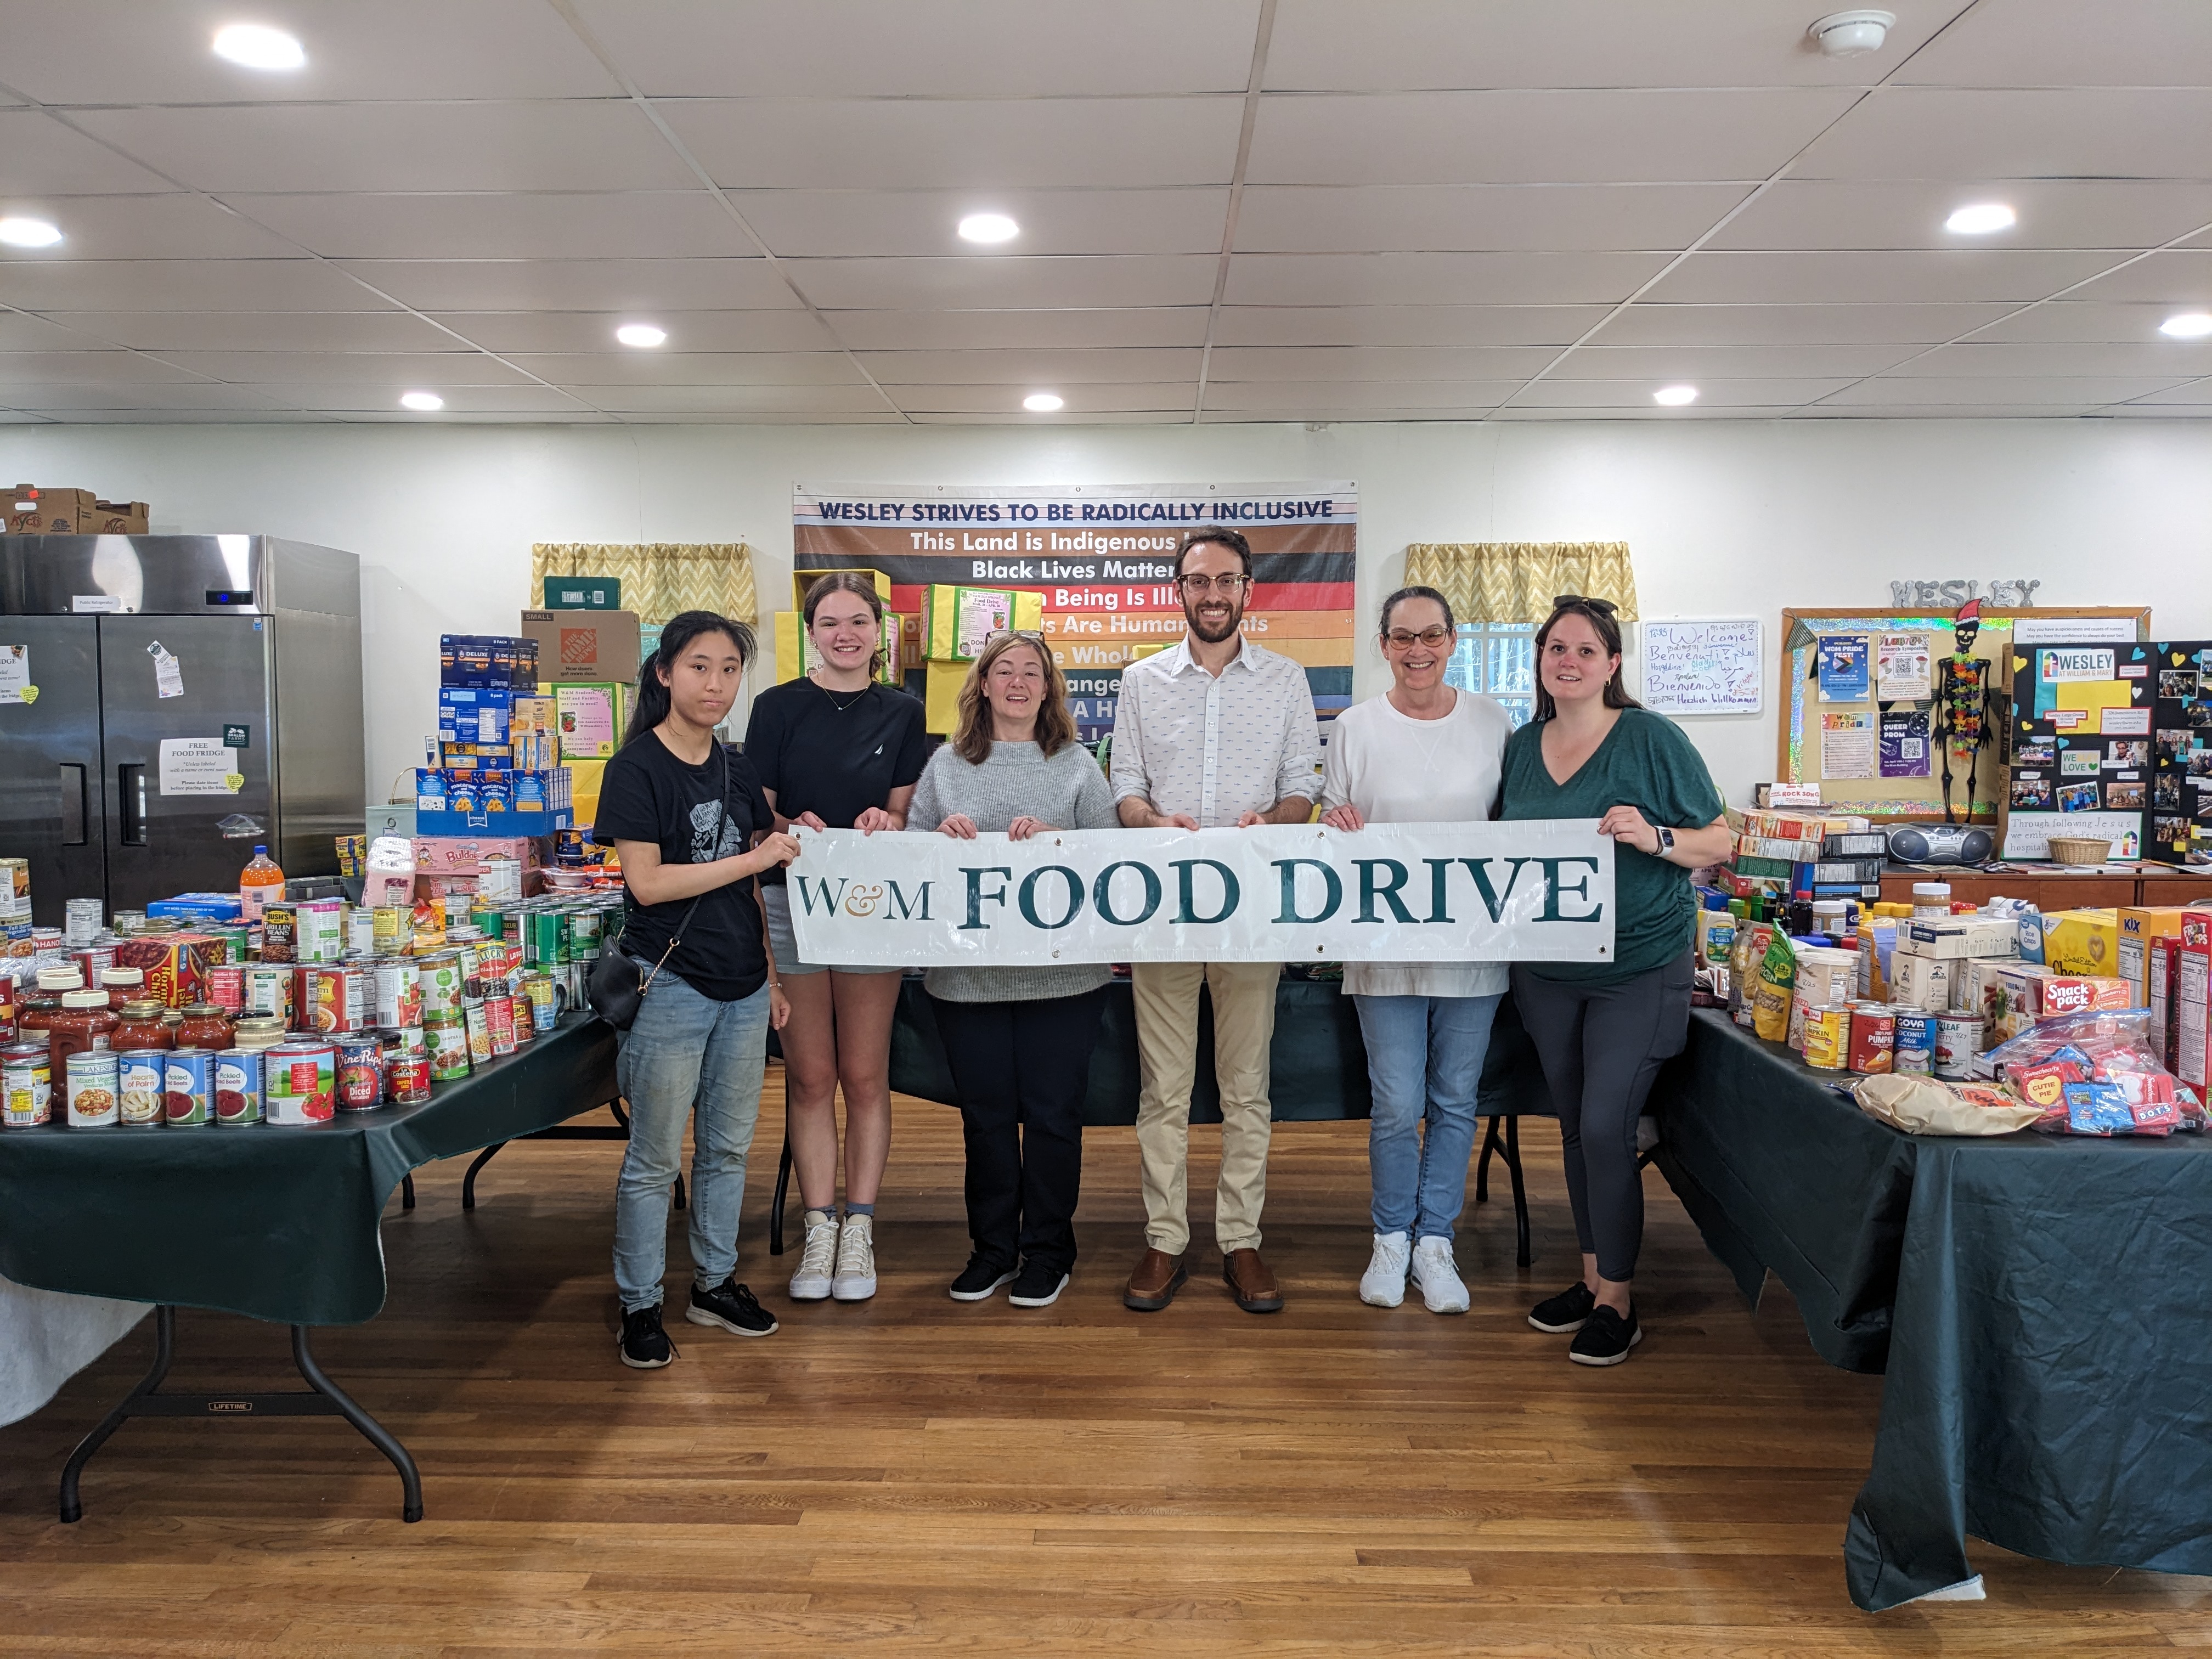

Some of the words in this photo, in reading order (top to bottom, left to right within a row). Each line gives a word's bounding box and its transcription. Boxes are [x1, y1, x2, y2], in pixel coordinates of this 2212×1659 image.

[819, 501, 904, 522] WESLEY
[912, 504, 1001, 522] STRIVES
[1009, 503, 1039, 522] TO
[1048, 504, 1073, 521] BE
[1082, 502, 1205, 522] RADICALLY
[1212, 500, 1333, 520] INCLUSIVE
[911, 532, 956, 551] This
[963, 532, 1017, 551] Land
[1026, 532, 1043, 551] is
[1051, 532, 1175, 556] Indigenous
[973, 561, 1033, 579] Black
[1040, 560, 1095, 579] Lives
[1103, 561, 1175, 579] Matter
[1056, 588, 1119, 611] Being
[1127, 588, 1145, 606] Is
[1892, 579, 2040, 607] WESLEY
[1063, 616, 1102, 633] Are
[1110, 616, 1188, 633] Human
[561, 629, 597, 663] HOME
[566, 633, 580, 646] THE
[577, 642, 597, 663] DEPOT
[2059, 654, 2112, 670] WESLEY
[1677, 693, 1707, 704] Herzlich
[1711, 693, 1756, 704] Willkommen
[2063, 763, 2086, 771] LOVE
[2011, 819, 2049, 828] Through
[2052, 819, 2092, 828] following
[445, 849, 479, 863] Buldak
[794, 874, 935, 921] W&M
[956, 858, 1241, 930] FOOD
[1271, 856, 1604, 926] DRIVE
[2124, 916, 2140, 933] KIX
[2183, 922, 2207, 937] FROOT
[2185, 934, 2208, 946] LOOPS
[479, 950, 505, 962] LUCK'S
[2063, 953, 2080, 963] Limited
[2080, 957, 2097, 967] Edition
[2047, 984, 2089, 999] Snack
[2057, 994, 2089, 1009] pack
[1897, 1018, 1925, 1027] GOYA
[1895, 1029, 1927, 1038] COCONUT
[336, 1053, 360, 1068] Vine
[361, 1049, 381, 1066] Ripe
[2023, 1065, 2062, 1079] Sweethearts
[349, 1086, 371, 1095] Diced
[2033, 1081, 2055, 1091] CUTIE
[2138, 1104, 2172, 1121] DOTS
